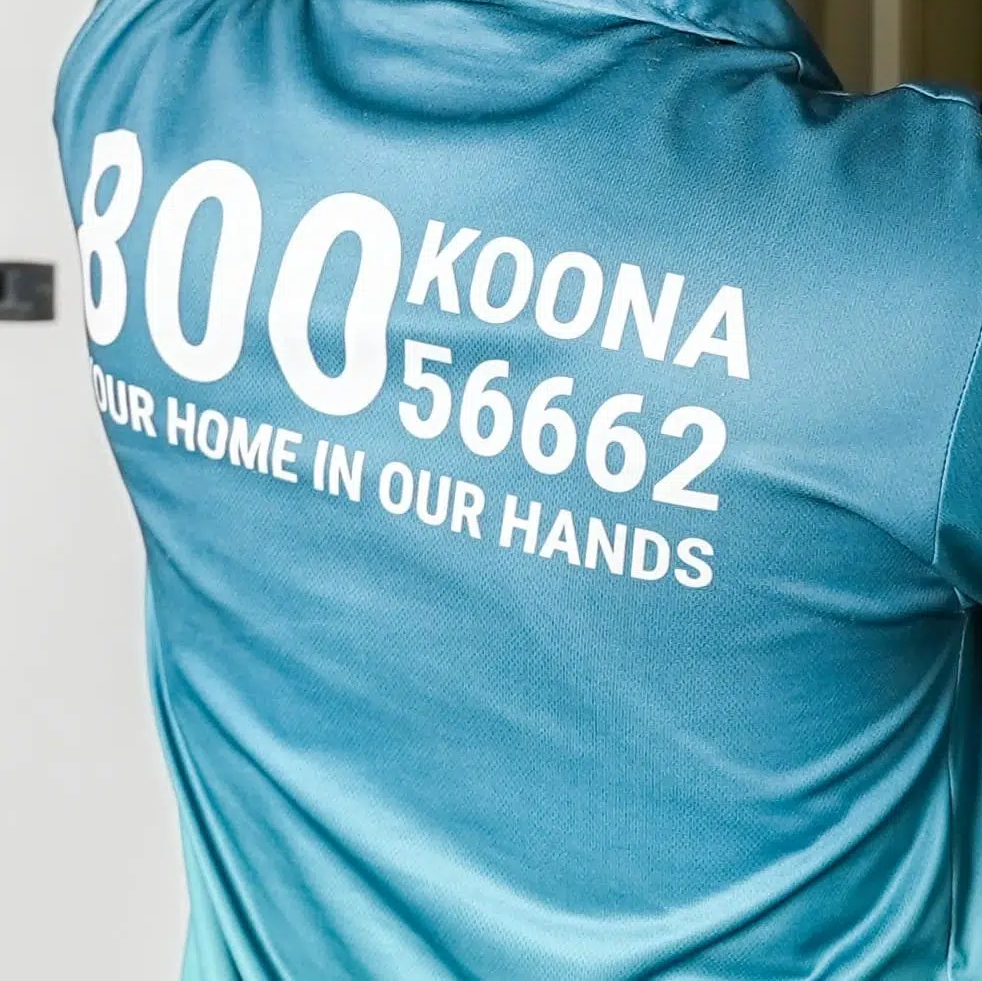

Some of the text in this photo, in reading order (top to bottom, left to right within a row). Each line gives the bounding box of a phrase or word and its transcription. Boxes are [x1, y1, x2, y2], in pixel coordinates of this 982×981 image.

[76, 129, 751, 417] 800 KOONA
[89, 356, 714, 588] OUR HOME IN OUR HANDS
[398, 339, 727, 512] 56662
